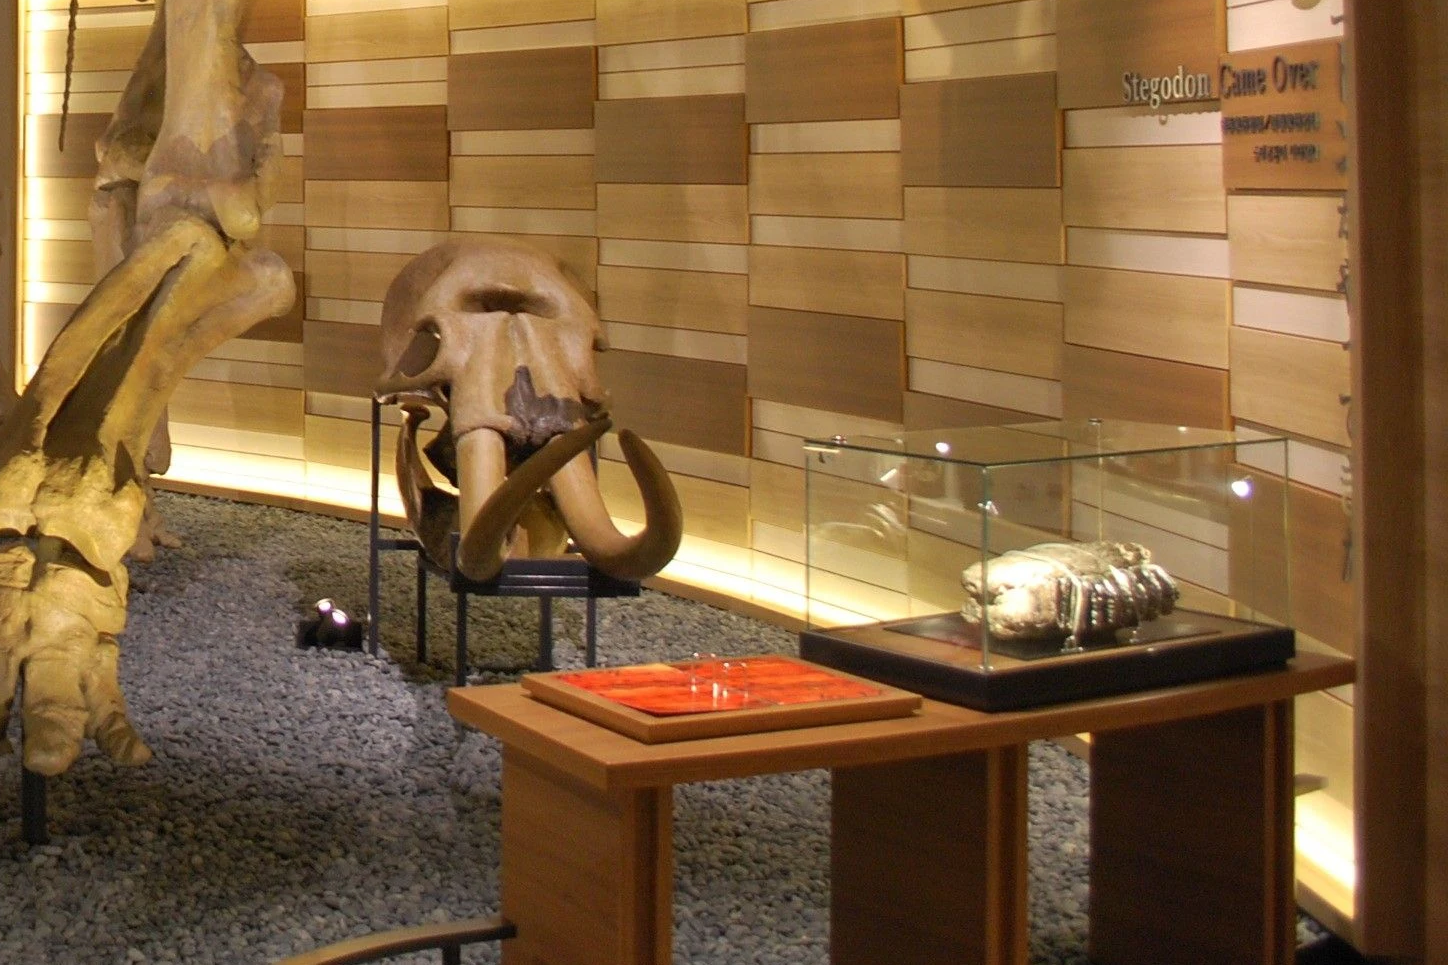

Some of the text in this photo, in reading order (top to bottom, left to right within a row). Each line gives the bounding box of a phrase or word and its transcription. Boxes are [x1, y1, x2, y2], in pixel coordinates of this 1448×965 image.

[1122, 55, 1319, 109] Stegodon Came Over
